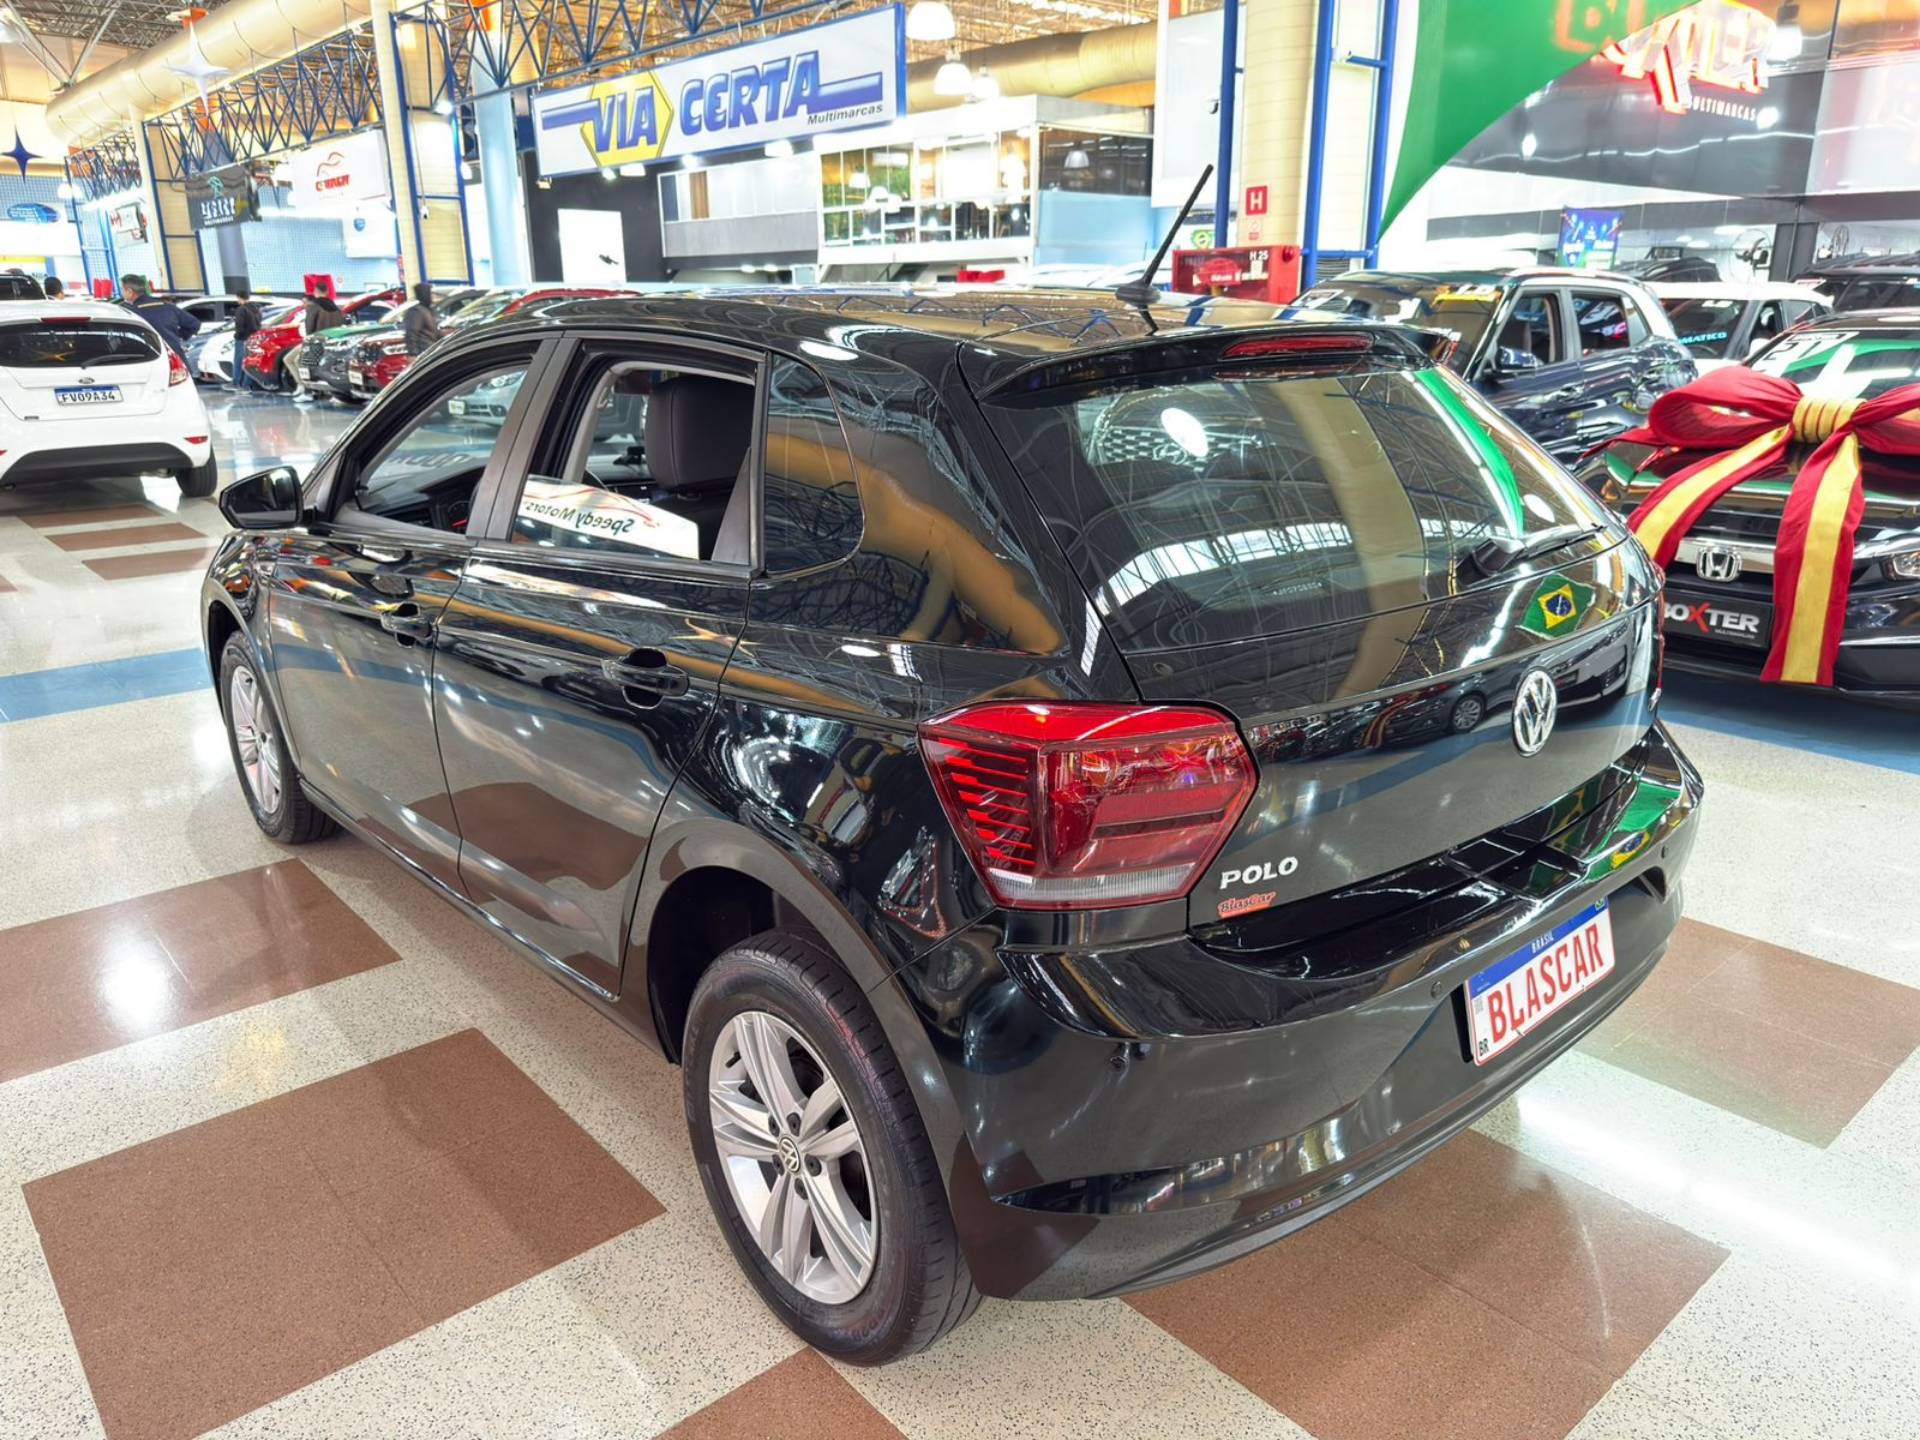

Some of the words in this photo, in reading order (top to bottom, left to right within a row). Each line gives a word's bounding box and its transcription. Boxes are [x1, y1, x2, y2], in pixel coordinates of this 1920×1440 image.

[592, 86, 659, 153] VIA
[679, 50, 820, 136] CERTA
[807, 104, 884, 126] Multimarcas
[1691, 95, 1757, 122] ULTIMARCAS
[1250, 191, 1263, 211] H
[1219, 856, 1299, 890] POLO
[1531, 930, 1555, 954] BRASIL
[1487, 922, 1604, 1044] BLASCAR
